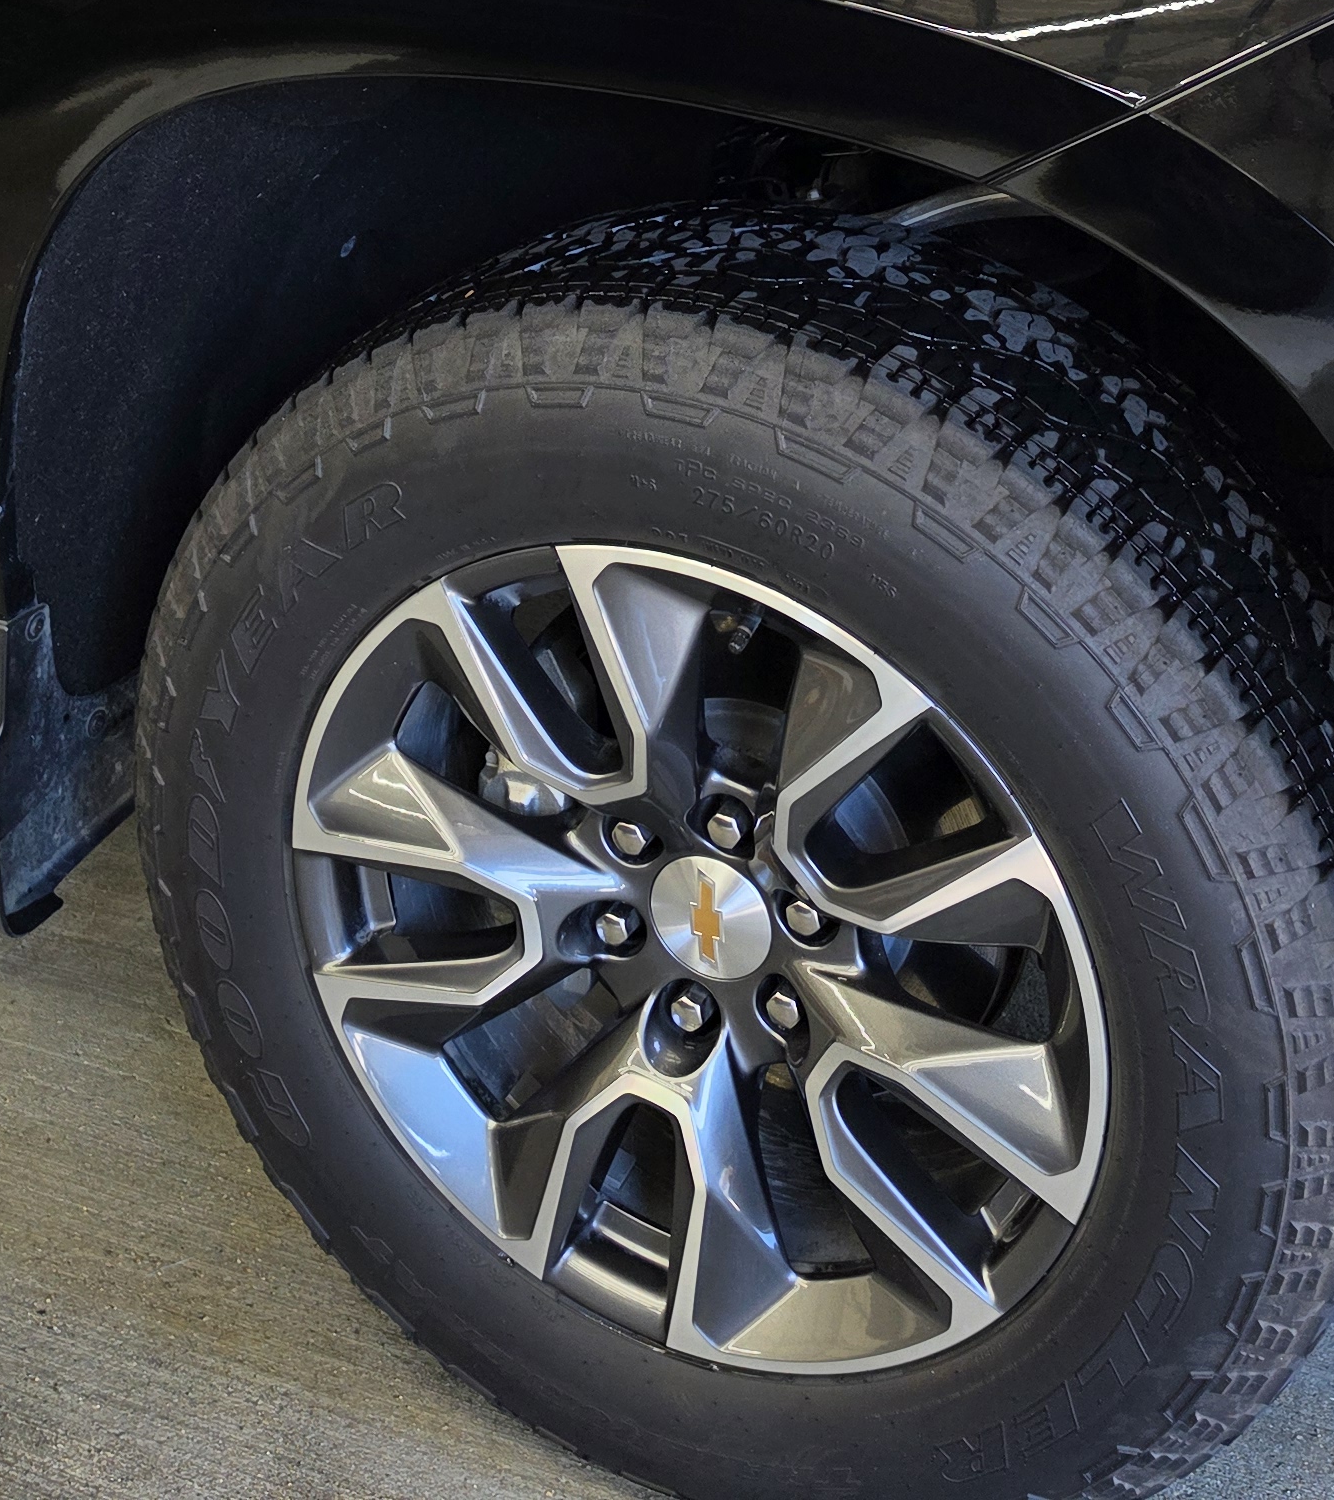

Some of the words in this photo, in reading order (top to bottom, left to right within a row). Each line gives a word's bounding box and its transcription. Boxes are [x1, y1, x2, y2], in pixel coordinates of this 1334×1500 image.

[185, 480, 407, 1149] GOODYEAR
[692, 485, 835, 560] 275/60R20
[933, 797, 1225, 1485] WRANGLER
